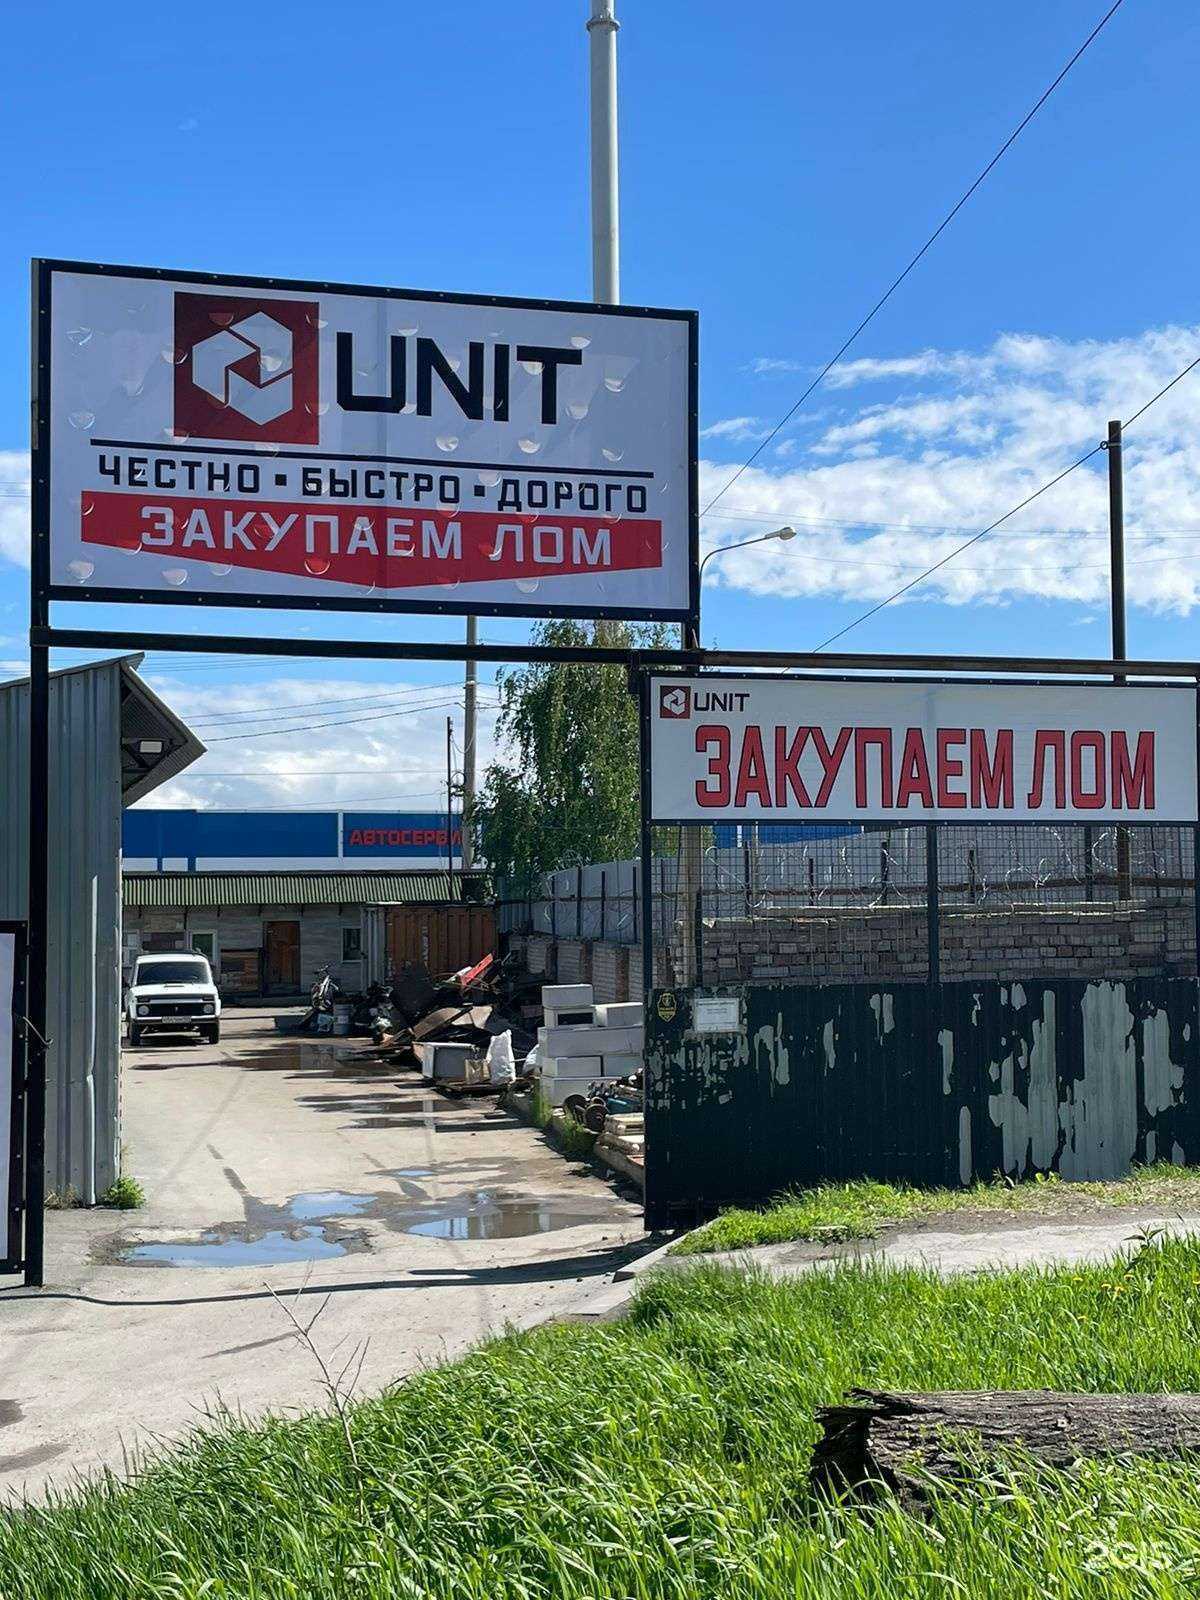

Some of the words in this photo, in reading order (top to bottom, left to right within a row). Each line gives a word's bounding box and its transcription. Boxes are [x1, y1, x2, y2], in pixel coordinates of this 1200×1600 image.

[336, 332, 582, 424] UNIT
[99, 455, 260, 494] ЧЕСТНО
[301, 467, 460, 504] БЫСТРО
[498, 478, 647, 514] ДОРОГО
[141, 506, 462, 560] ЗАКУПАЕМ
[491, 524, 612, 566] ЛОМ
[693, 692, 750, 712] UNIT
[695, 725, 1014, 809] ЗАКУПАЕМ
[1027, 730, 1155, 810] ЛОМ
[350, 829, 464, 846] АВТОСЕРВИ
